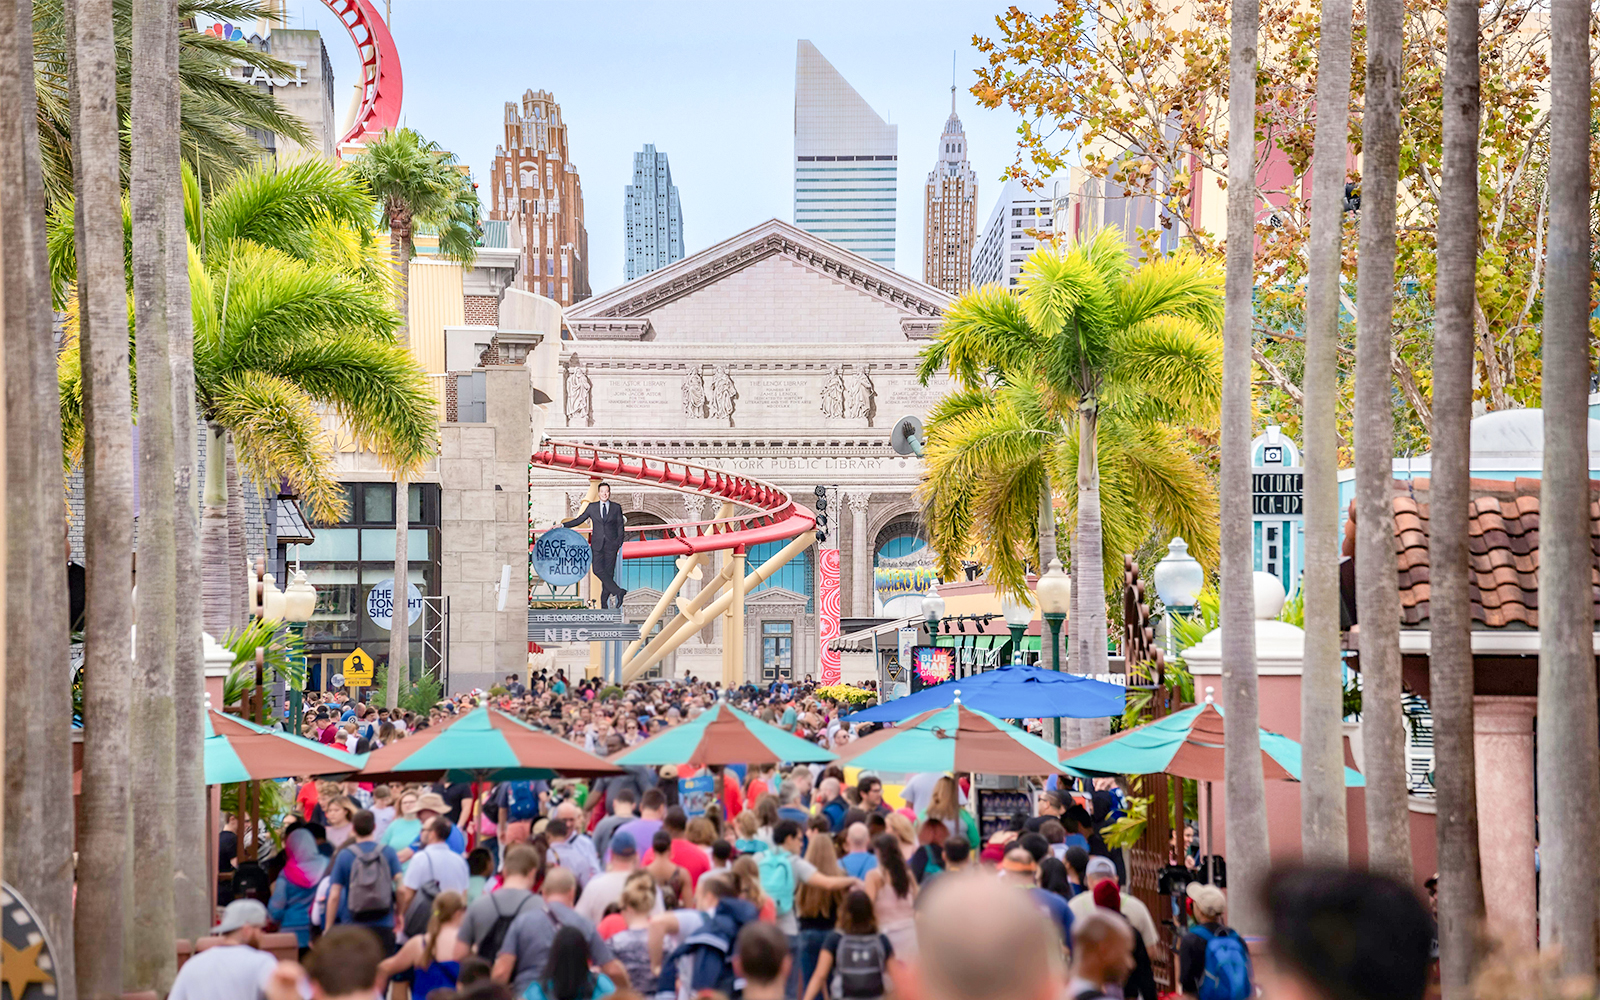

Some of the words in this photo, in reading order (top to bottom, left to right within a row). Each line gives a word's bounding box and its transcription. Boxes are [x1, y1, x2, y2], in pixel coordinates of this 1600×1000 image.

[732, 460, 764, 470] YORK
[771, 460, 818, 470] PUBLIC
[826, 460, 884, 470] LIBRARY
[1255, 474, 1299, 492] ICTURE
[1255, 495, 1299, 514] ICK-UP
[536, 540, 566, 549] RACE
[536, 548, 560, 558] NEW
[563, 548, 590, 558] YORK
[556, 557, 589, 566] JIMMY
[550, 565, 588, 576] FALLON
[370, 590, 392, 598] THE
[370, 599, 422, 608] TONHT
[369, 608, 394, 618] SHO
[536, 614, 551, 622] THE
[552, 614, 588, 622] TONIGHT
[544, 628, 588, 642] NBC
[921, 654, 947, 662] BLUE
[921, 662, 947, 670] MAN
